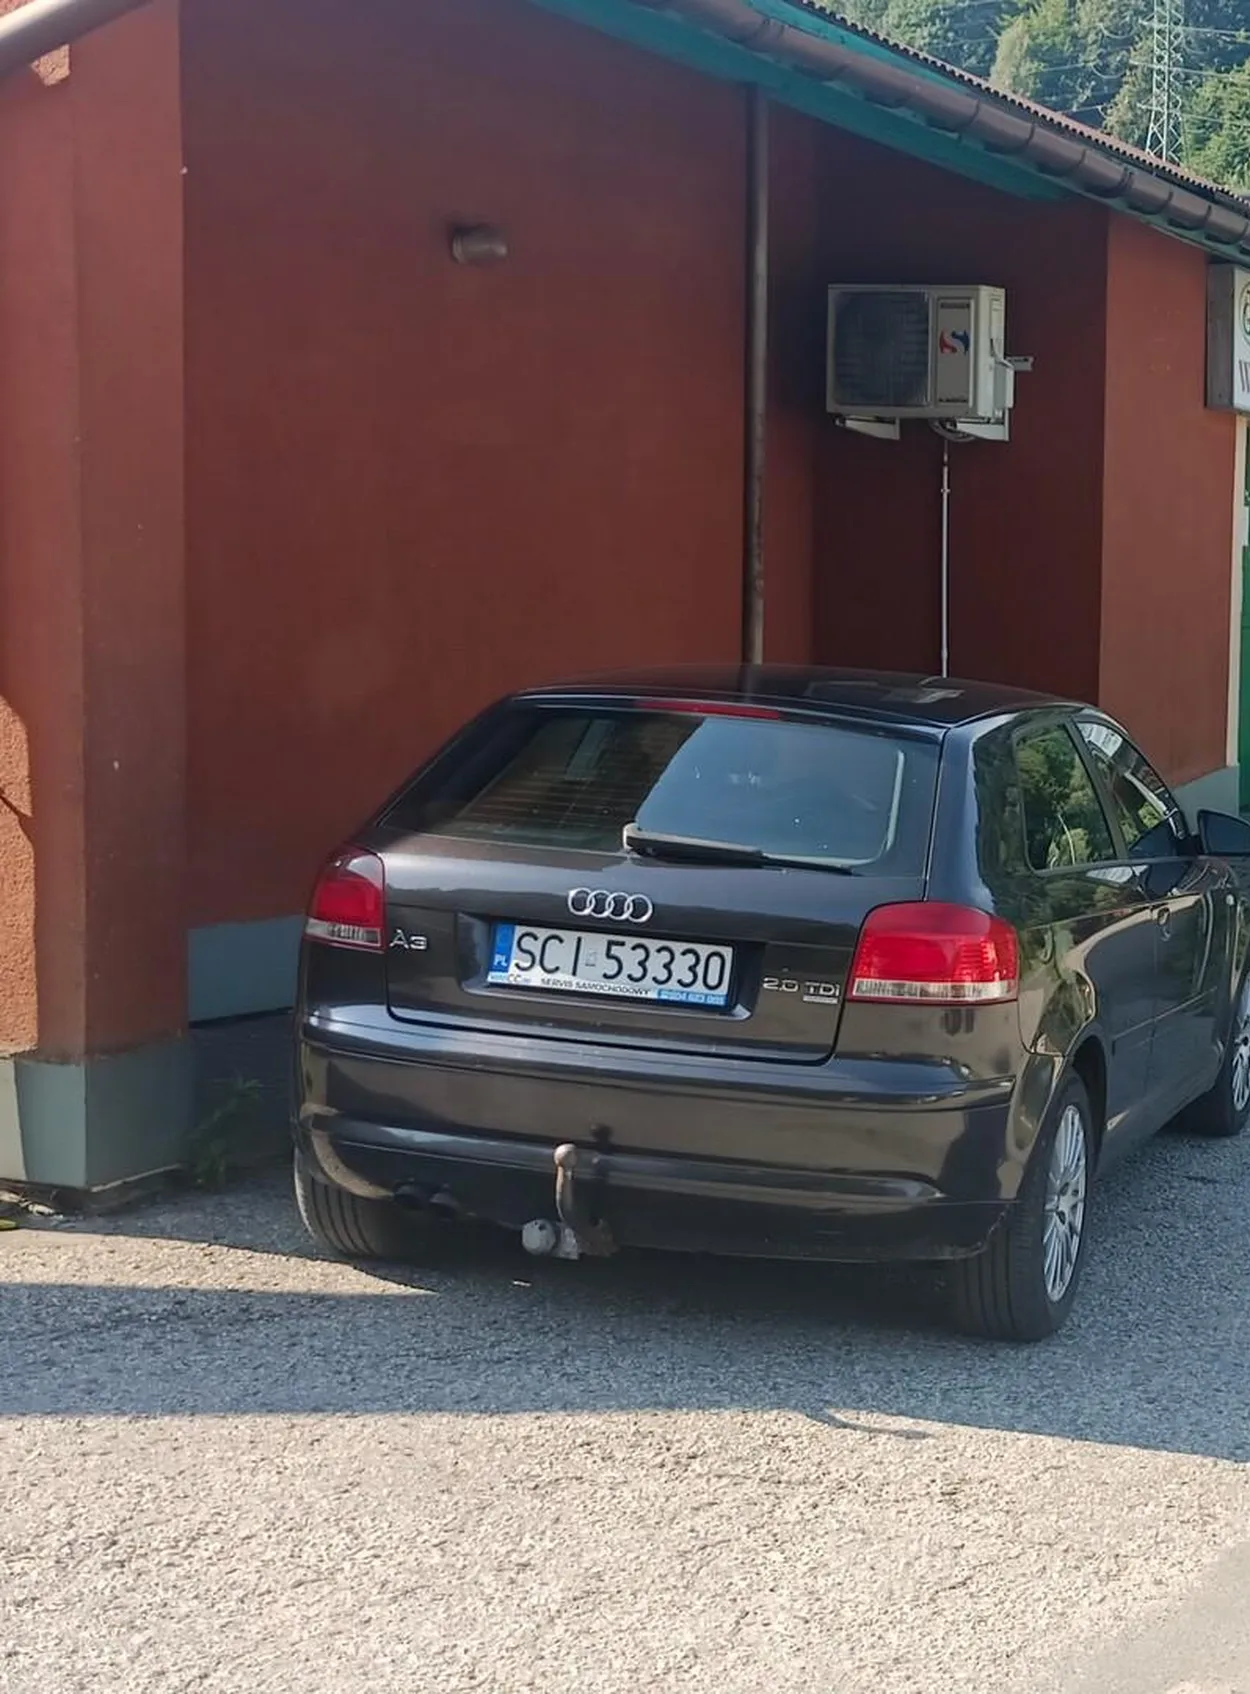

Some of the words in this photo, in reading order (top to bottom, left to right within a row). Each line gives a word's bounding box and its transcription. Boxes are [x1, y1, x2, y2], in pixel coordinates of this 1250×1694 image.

[389, 928, 428, 950] A3
[493, 954, 508, 967] PL
[515, 931, 582, 977] SCI
[603, 939, 727, 990] 53330
